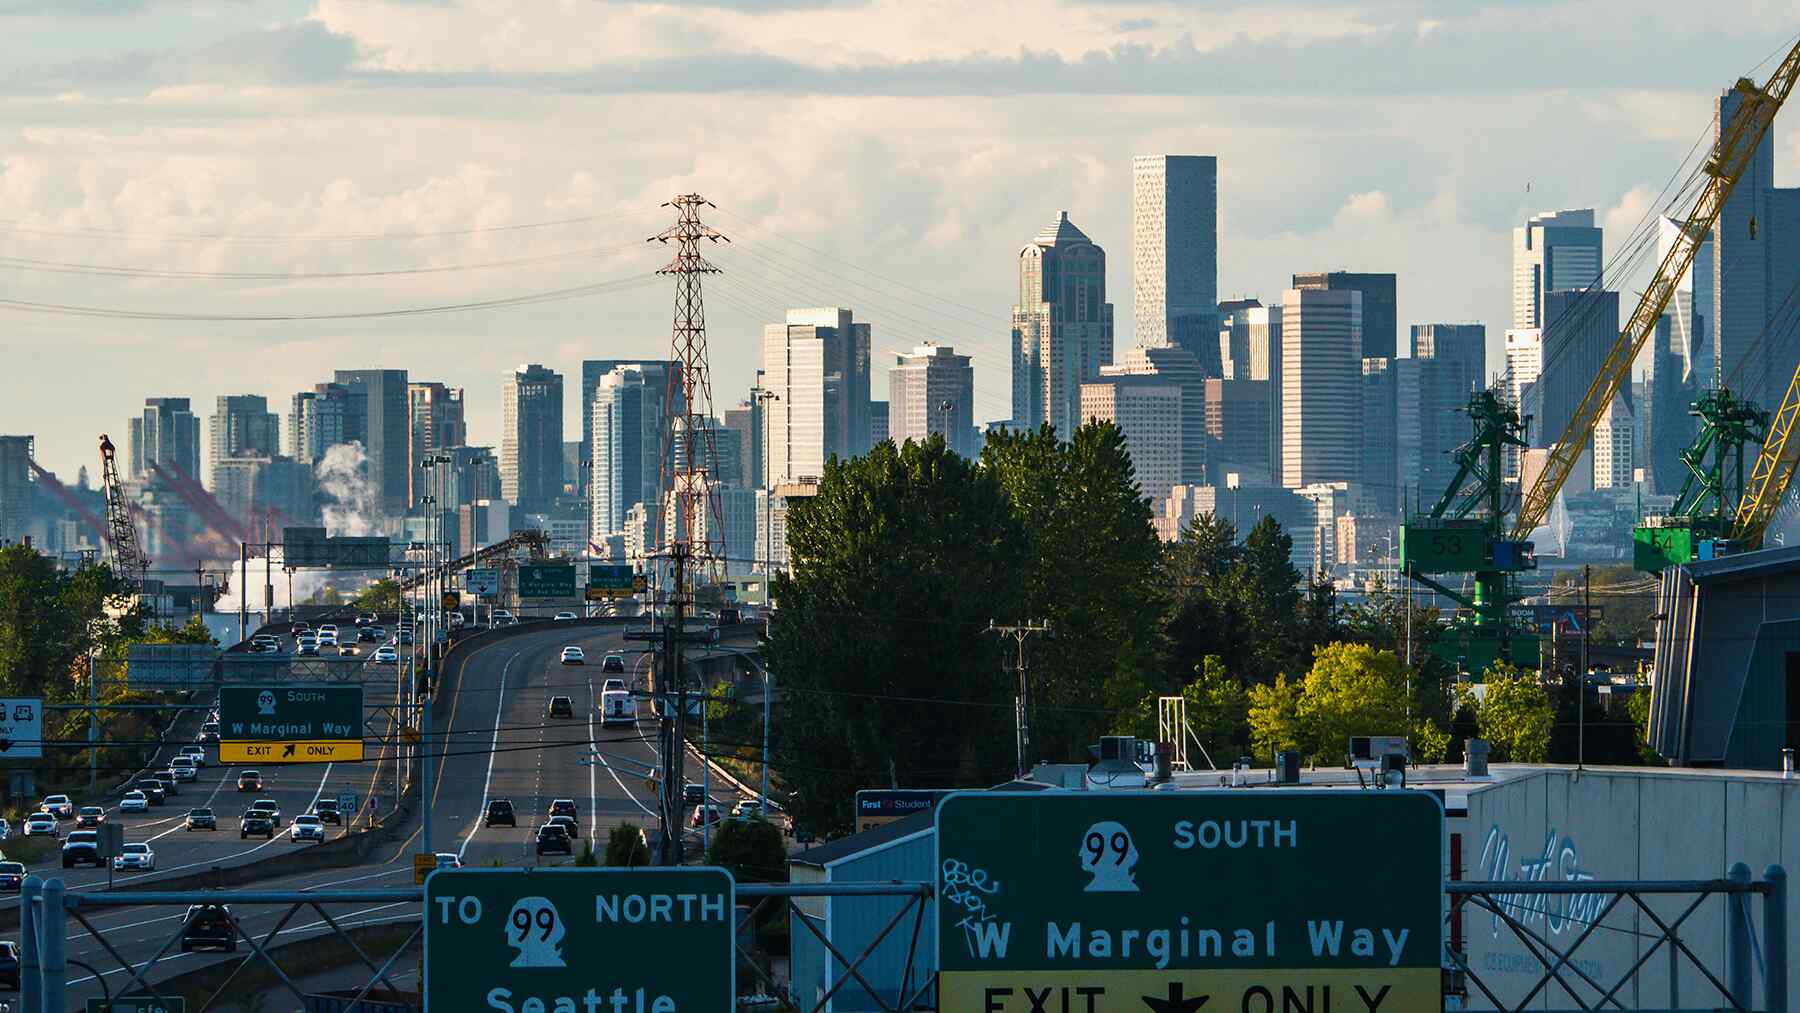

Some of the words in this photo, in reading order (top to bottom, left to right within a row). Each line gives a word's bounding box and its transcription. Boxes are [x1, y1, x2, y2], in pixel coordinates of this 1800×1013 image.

[1432, 535, 1462, 555] 53
[1652, 535, 1673, 552] 54
[259, 694, 273, 705] 99
[232, 723, 244, 735] W
[250, 723, 312, 737] Marginal
[322, 723, 352, 737] Way
[247, 746, 272, 756] EXIT
[306, 746, 335, 756] ONLY
[340, 802, 354, 810] 40
[862, 799, 881, 809] First
[895, 799, 931, 809] Student
[1174, 820, 1297, 848] SOUTH
[1086, 832, 1129, 866] 99
[434, 895, 483, 925] TO
[595, 894, 725, 923] NORTH
[512, 908, 554, 943] 99
[973, 922, 1012, 959] W
[1047, 916, 1276, 970] Marginal
[1307, 920, 1411, 967] Way
[486, 987, 676, 1013] Seattle
[984, 987, 1106, 1013] EXIT
[1241, 985, 1391, 1013] ONLY
